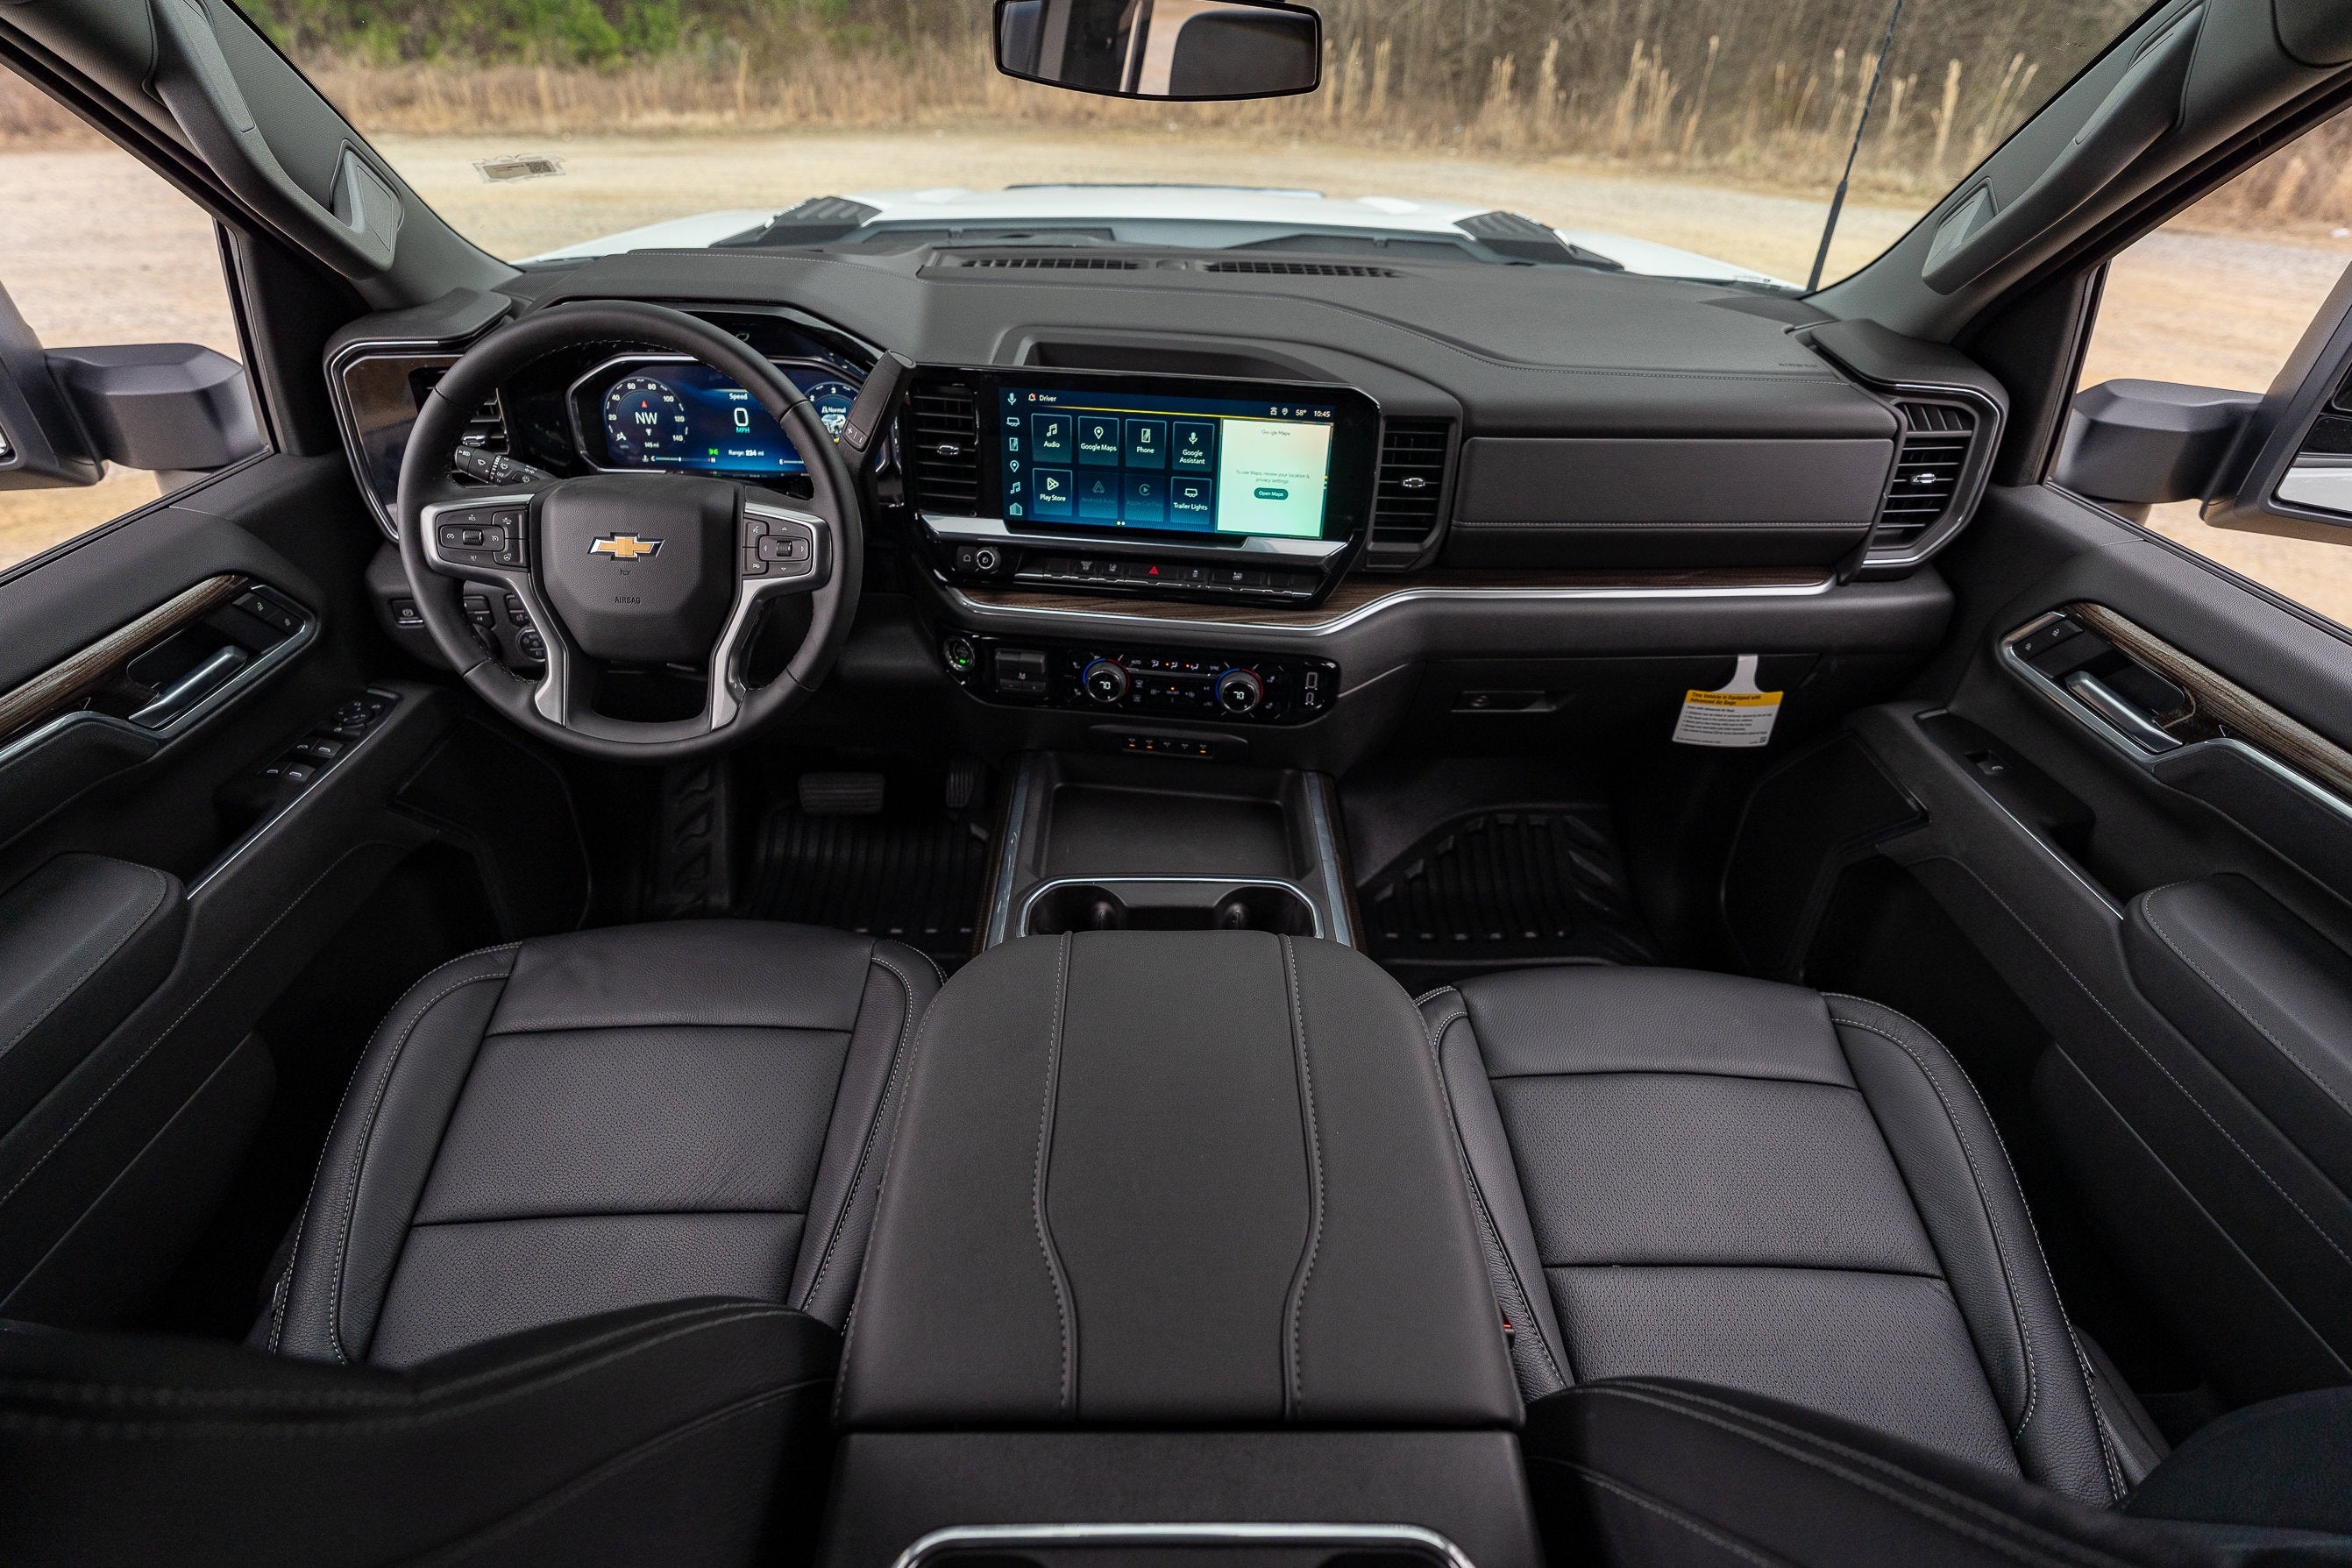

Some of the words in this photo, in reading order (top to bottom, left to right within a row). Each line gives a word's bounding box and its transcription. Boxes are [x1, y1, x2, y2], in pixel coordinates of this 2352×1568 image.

[635, 411, 657, 424] NW
[734, 408, 749, 427] 0
[1080, 443, 1100, 451] Google
[1101, 443, 1117, 452] Maps
[1183, 449, 1203, 458] Google
[1099, 681, 1111, 690] 70
[1233, 691, 1245, 699] 70
